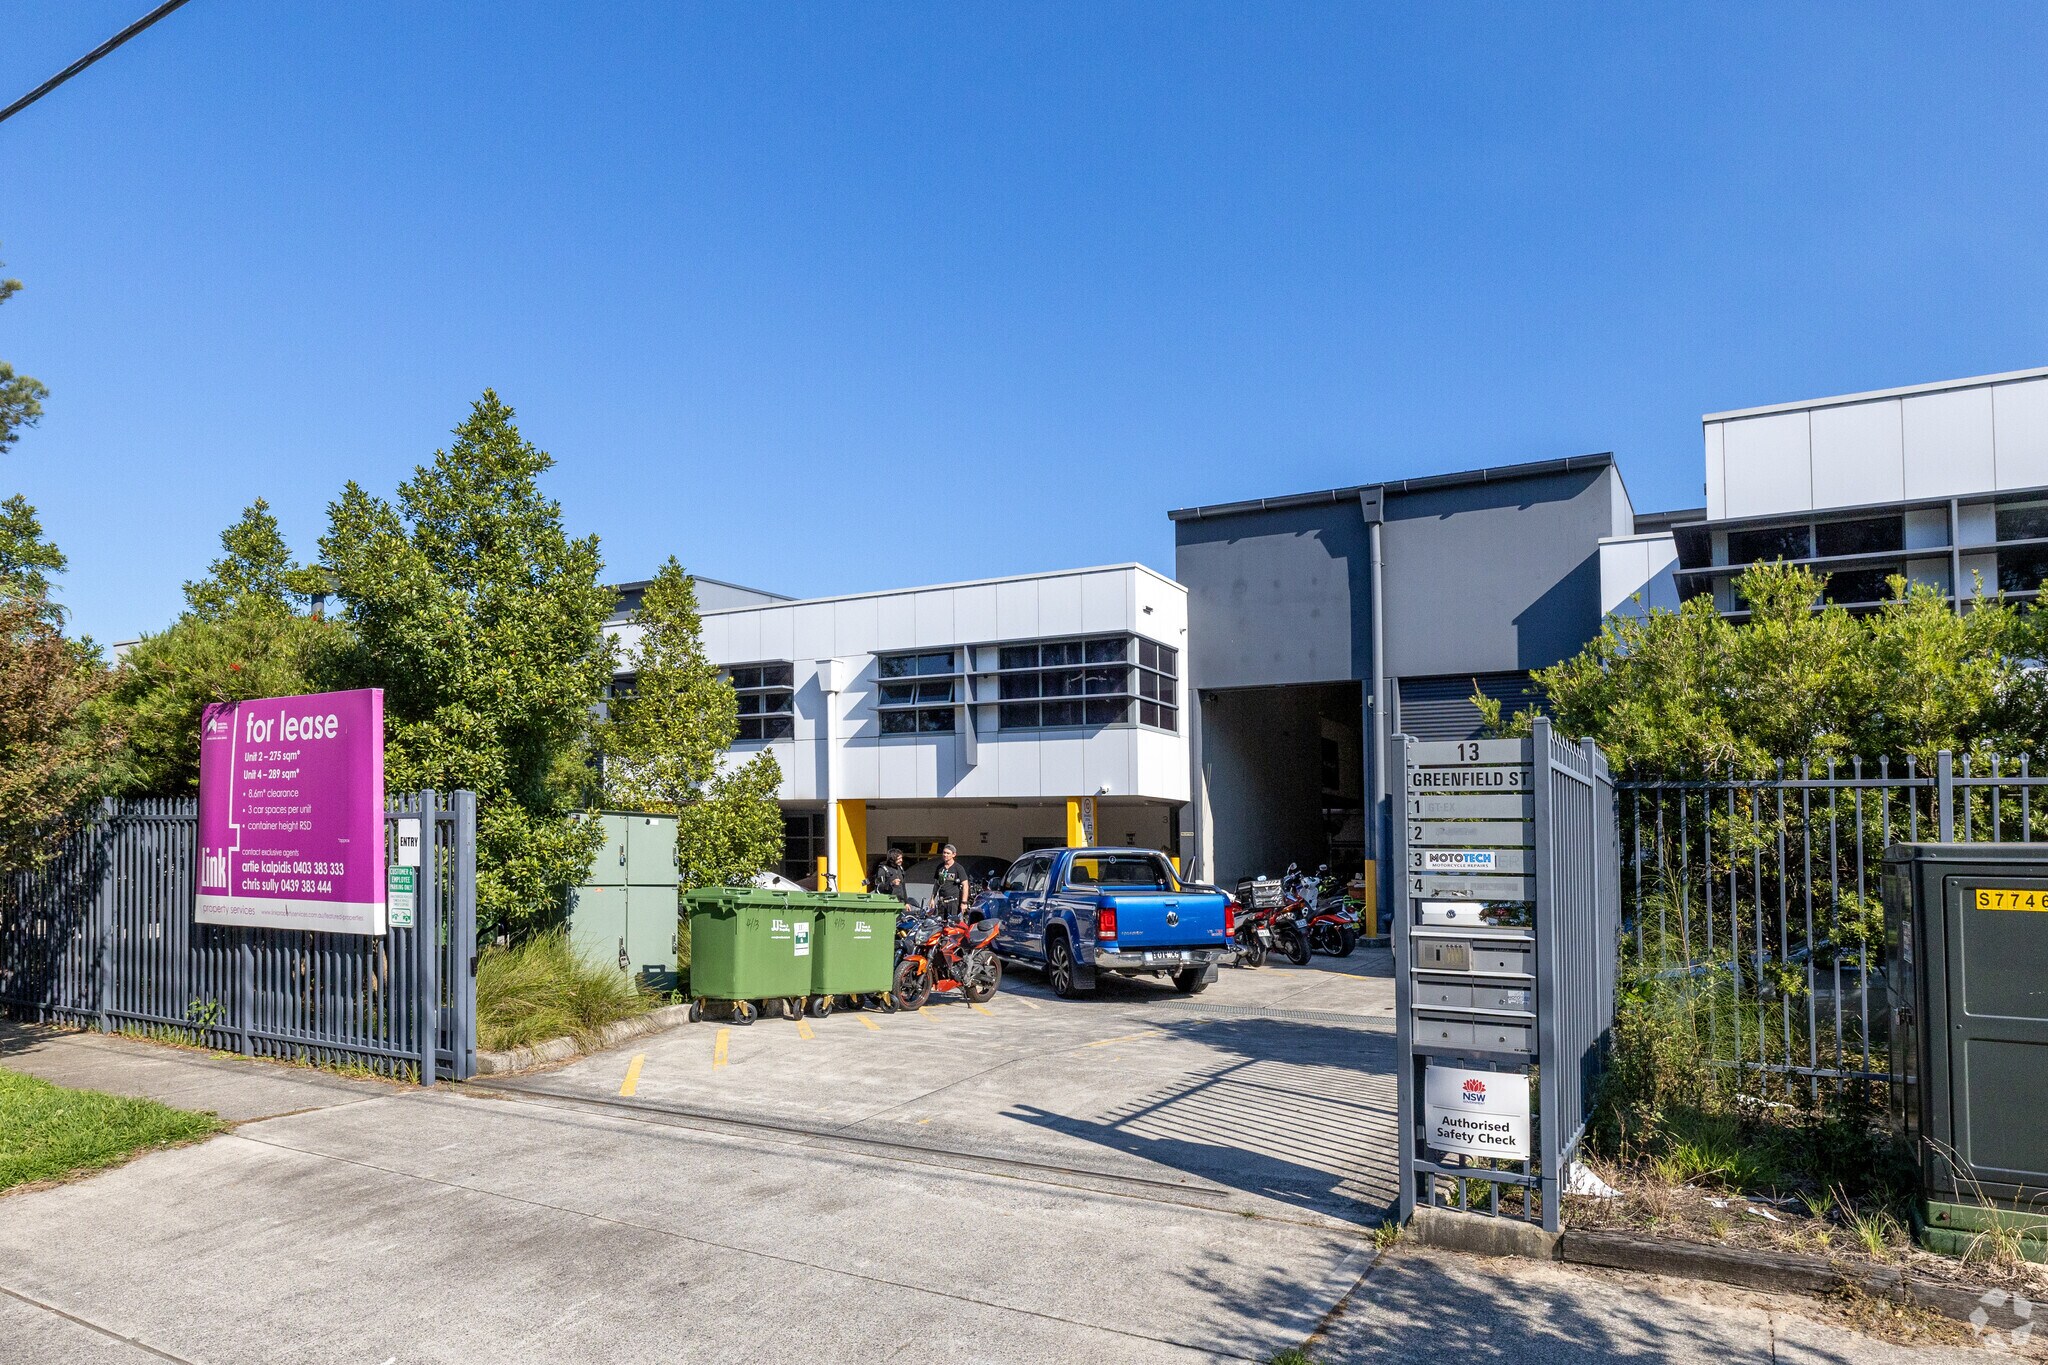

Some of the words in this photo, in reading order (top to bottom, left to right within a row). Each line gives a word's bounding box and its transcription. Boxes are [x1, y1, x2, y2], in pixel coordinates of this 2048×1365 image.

[246, 712, 274, 743] for
[279, 710, 339, 741] lease
[245, 752, 257, 762] Unit
[258, 752, 263, 761] 2
[269, 751, 281, 761] 275
[1457, 743, 1479, 761] 13
[244, 770, 256, 780] Unit
[257, 770, 262, 779] 4
[268, 769, 280, 779] 289
[1413, 772, 1503, 786] GREENFIELD
[1509, 772, 1530, 786] ST
[267, 789, 299, 798] clearance
[248, 805, 252, 813] 3
[265, 805, 286, 815] spaces
[287, 806, 299, 815] per
[300, 804, 312, 813] unit
[1414, 800, 1420, 813] 1
[248, 821, 278, 830] container
[278, 820, 298, 832] height
[300, 821, 312, 830] RSD
[1414, 826, 1422, 840] 2
[400, 836, 418, 847] ENTRY
[242, 848, 260, 856] contact
[261, 848, 282, 856] exclusive
[283, 849, 299, 858] agents
[1415, 853, 1422, 866] 3
[1430, 853, 1491, 863] MOTOTECH
[242, 861, 259, 873] artie
[261, 860, 292, 876] kalpidis
[293, 861, 311, 874] 0403
[314, 862, 328, 875] 383
[330, 863, 344, 876] 333
[242, 878, 260, 891] chris
[261, 879, 280, 894] sully
[280, 880, 299, 892] 0439
[301, 880, 316, 893] 383
[317, 881, 332, 894] 444
[1414, 879, 1423, 892] 4
[1979, 893, 2048, 908] S7746
[202, 904, 229, 915] property
[230, 904, 255, 915] services
[1463, 1092, 1486, 1102] NSW
[1442, 1116, 1510, 1132] Authorised
[1437, 1128, 1474, 1143] Safety
[1478, 1133, 1516, 1146] Check
